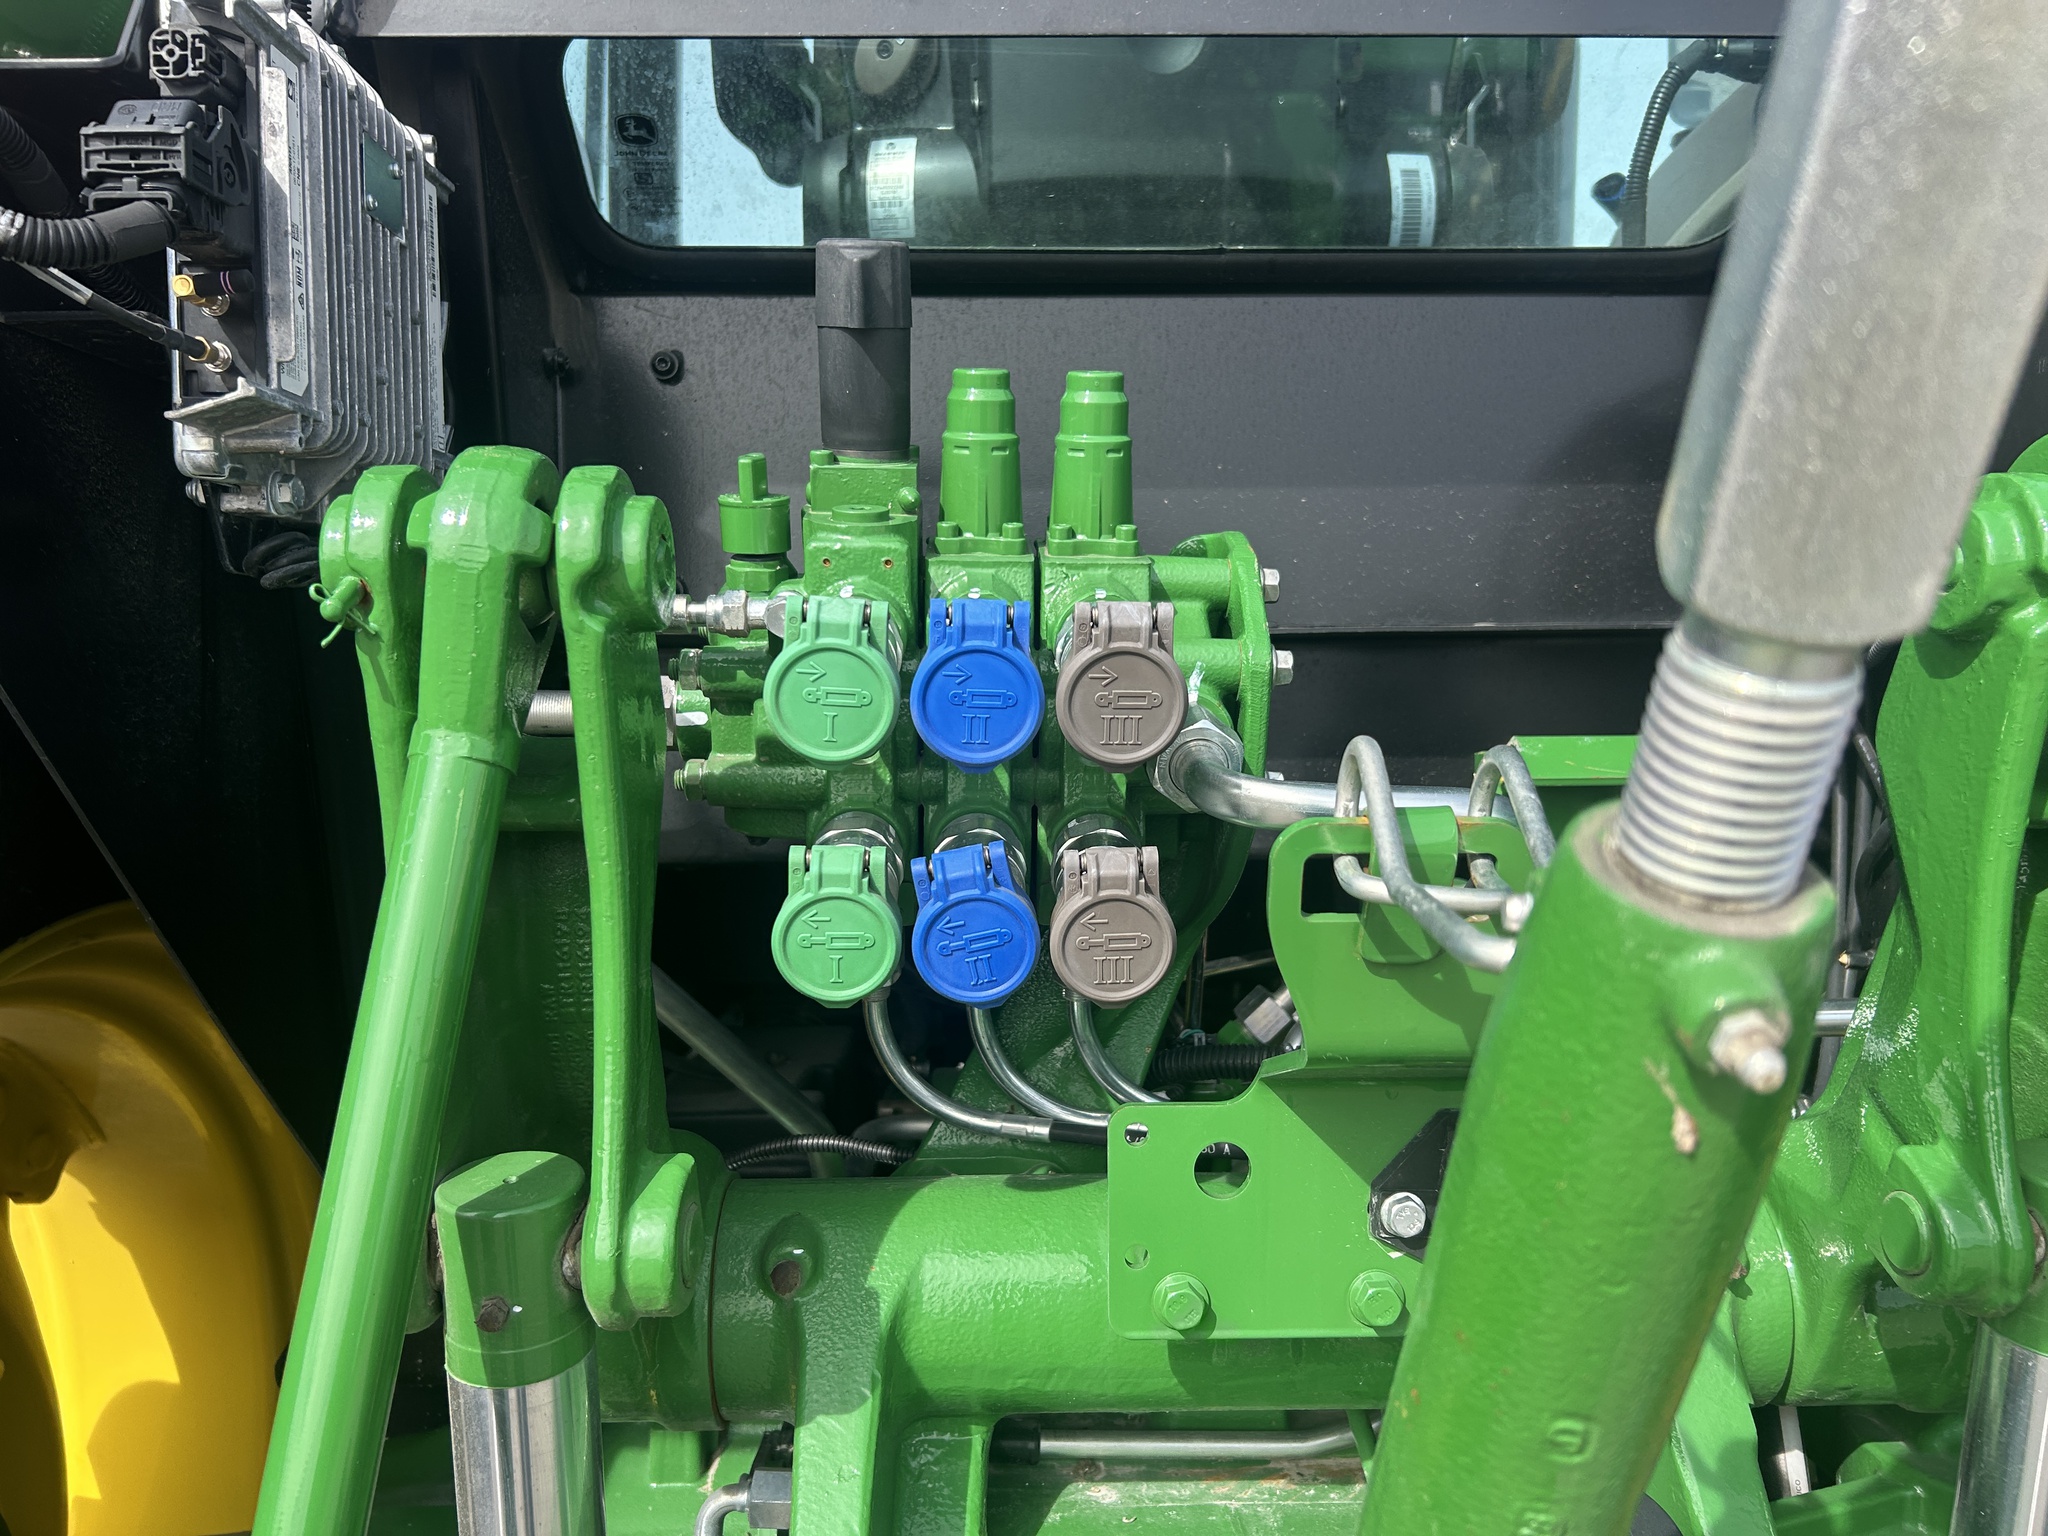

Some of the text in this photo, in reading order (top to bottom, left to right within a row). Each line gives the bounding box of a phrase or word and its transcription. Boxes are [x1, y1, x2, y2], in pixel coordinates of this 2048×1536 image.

[822, 711, 838, 743] I
[961, 713, 991, 745] II
[1099, 715, 1143, 746] III
[829, 954, 844, 984] I
[964, 953, 997, 986] II
[1093, 955, 1135, 985] III
[1222, 1143, 1231, 1156] A
